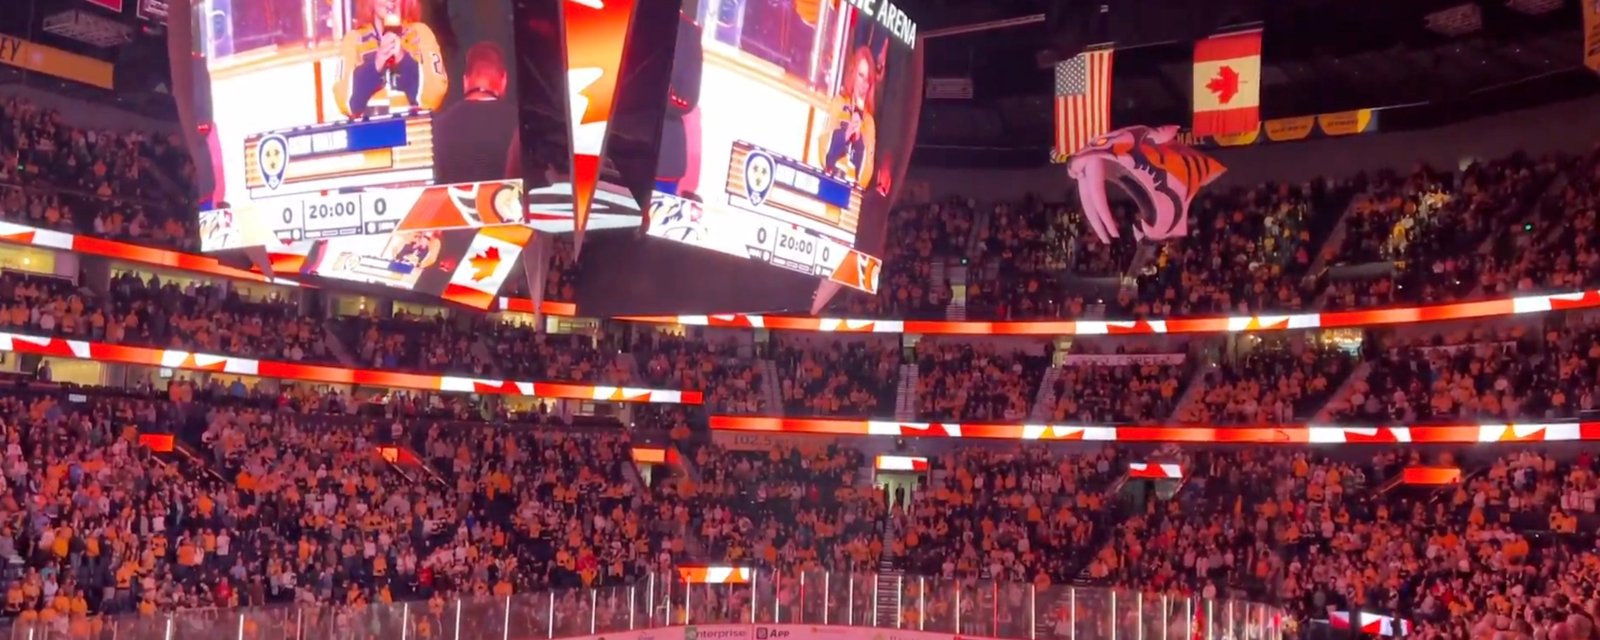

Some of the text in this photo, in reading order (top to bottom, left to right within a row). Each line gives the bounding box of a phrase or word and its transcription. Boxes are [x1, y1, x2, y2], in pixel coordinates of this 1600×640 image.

[877, 0, 917, 50] ARENA
[282, 197, 387, 224] 0 20:00 0
[757, 227, 830, 262] 0 20:00 0
